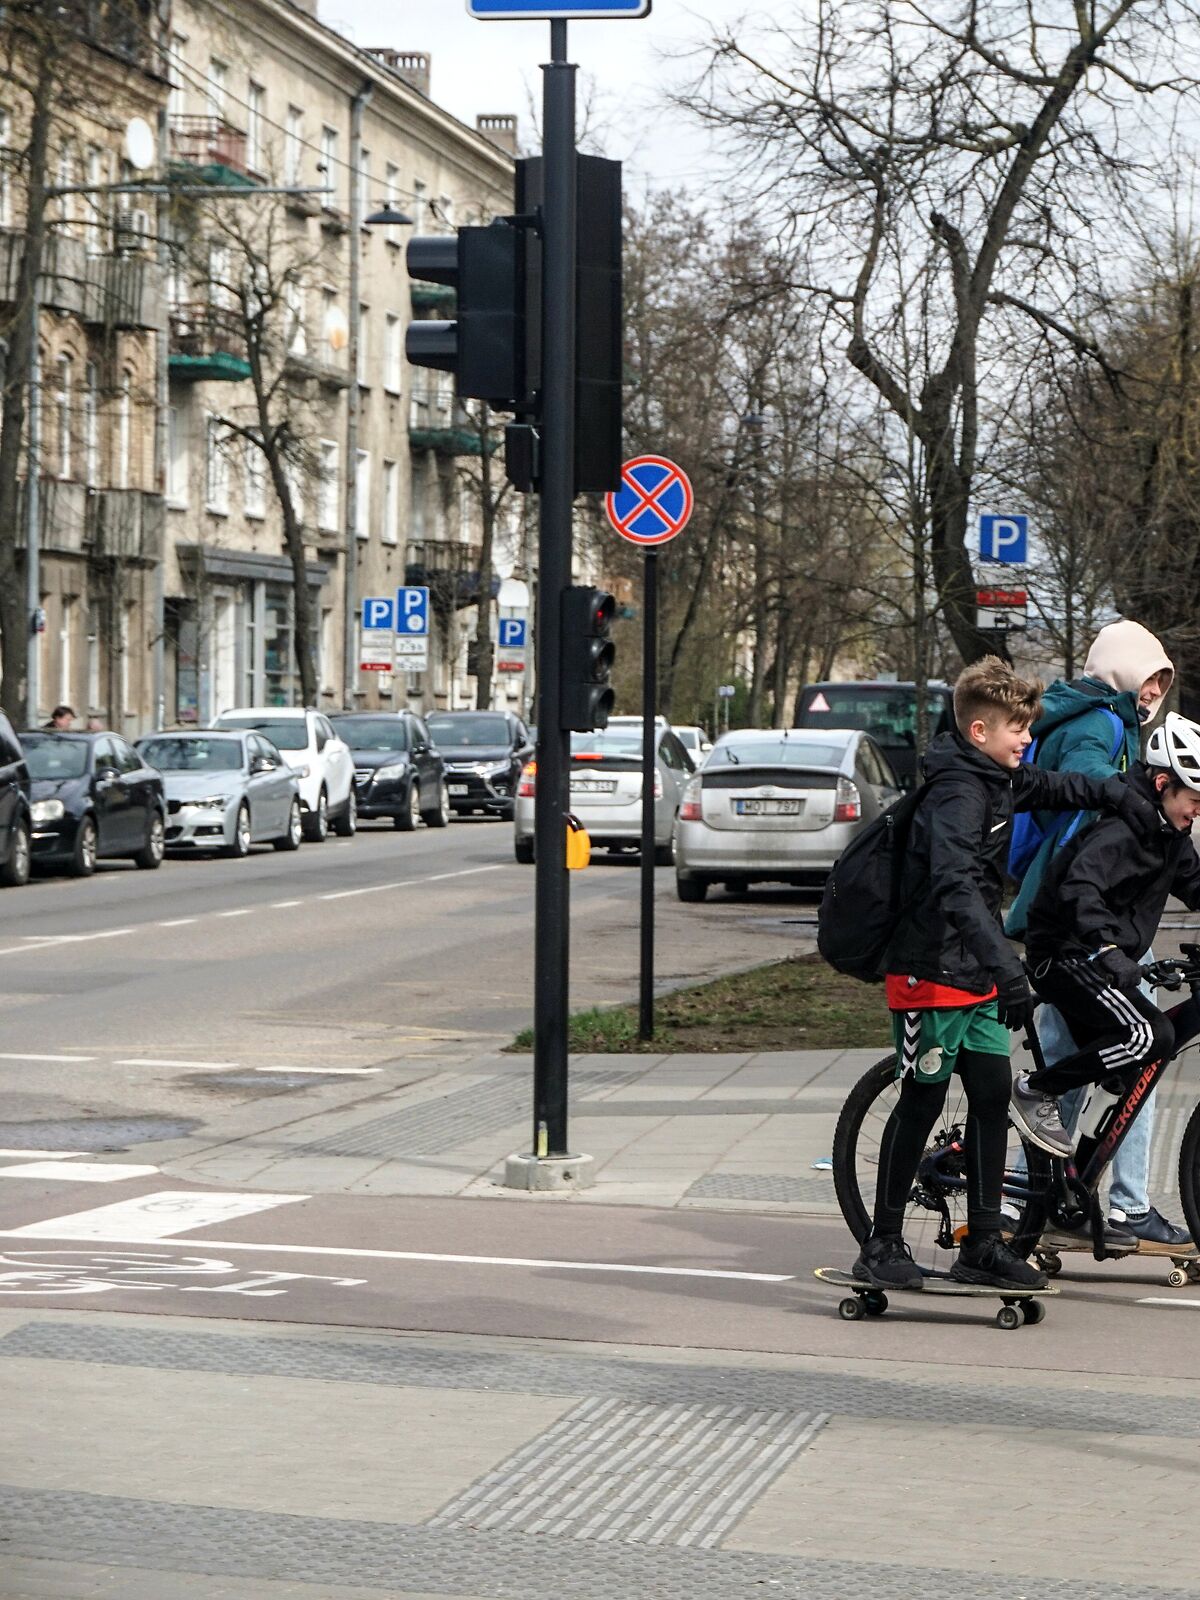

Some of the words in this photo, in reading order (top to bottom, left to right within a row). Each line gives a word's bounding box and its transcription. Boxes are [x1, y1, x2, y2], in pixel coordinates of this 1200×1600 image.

[992, 519, 1020, 559] P
[371, 601, 390, 627] P
[404, 590, 423, 615] P
[505, 620, 522, 643] P
